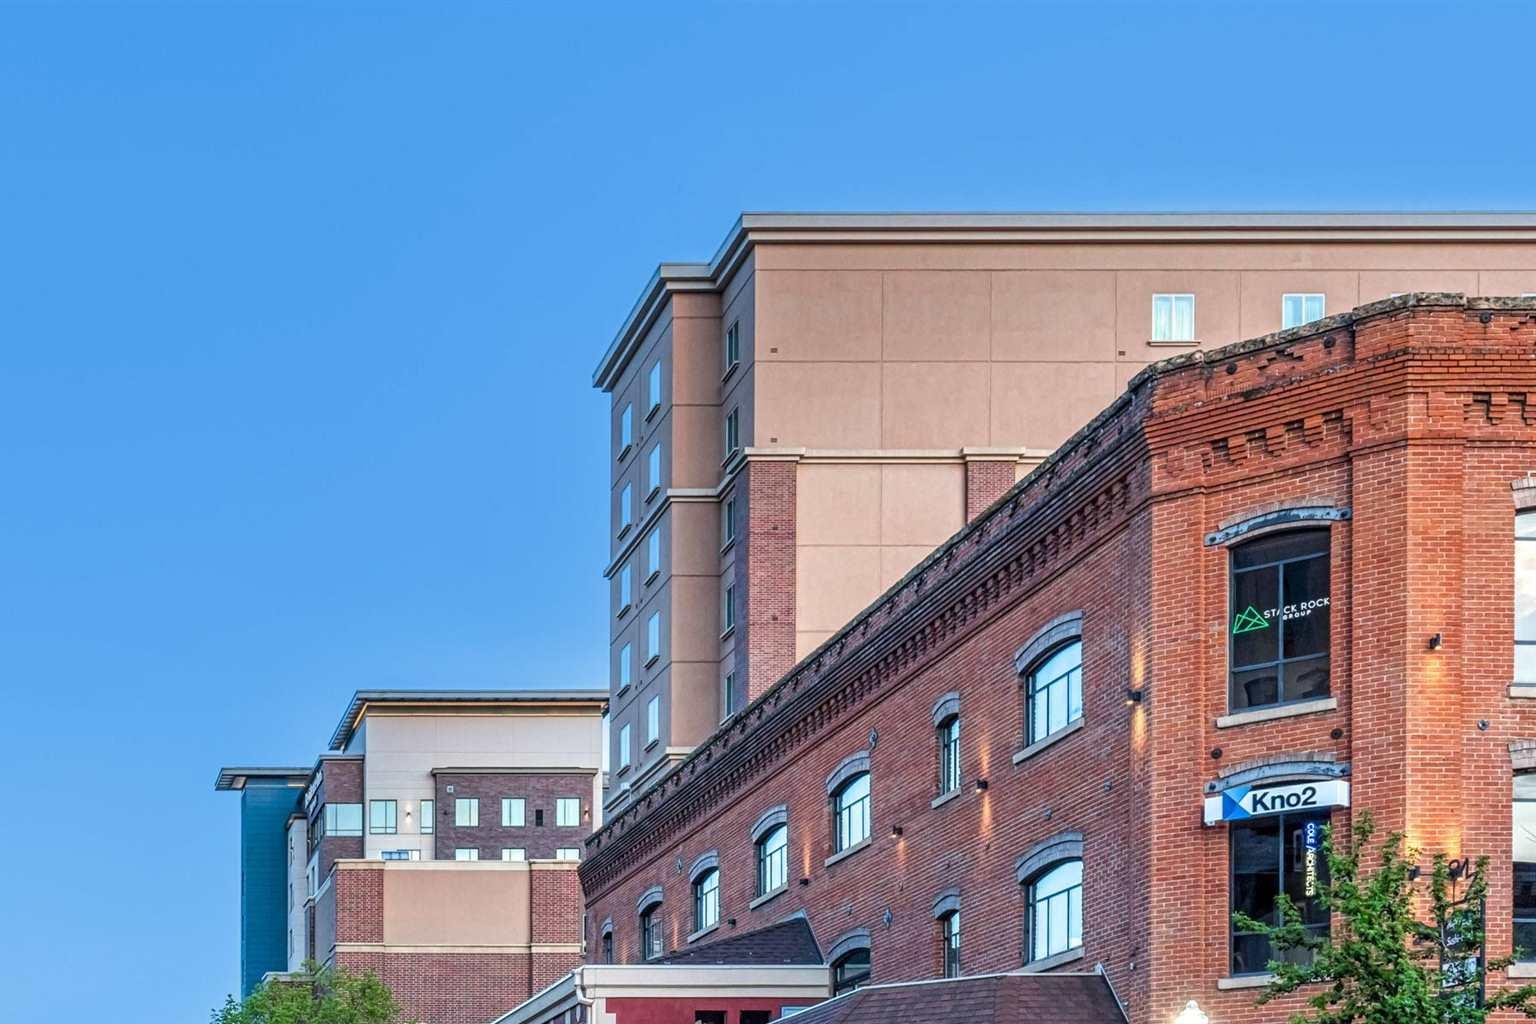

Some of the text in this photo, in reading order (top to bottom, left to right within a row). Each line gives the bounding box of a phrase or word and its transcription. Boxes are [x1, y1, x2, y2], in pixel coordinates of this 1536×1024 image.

[1300, 597, 1330, 610] ROCK
[1282, 609, 1312, 620] GROUP
[1252, 786, 1317, 813] Kno2
